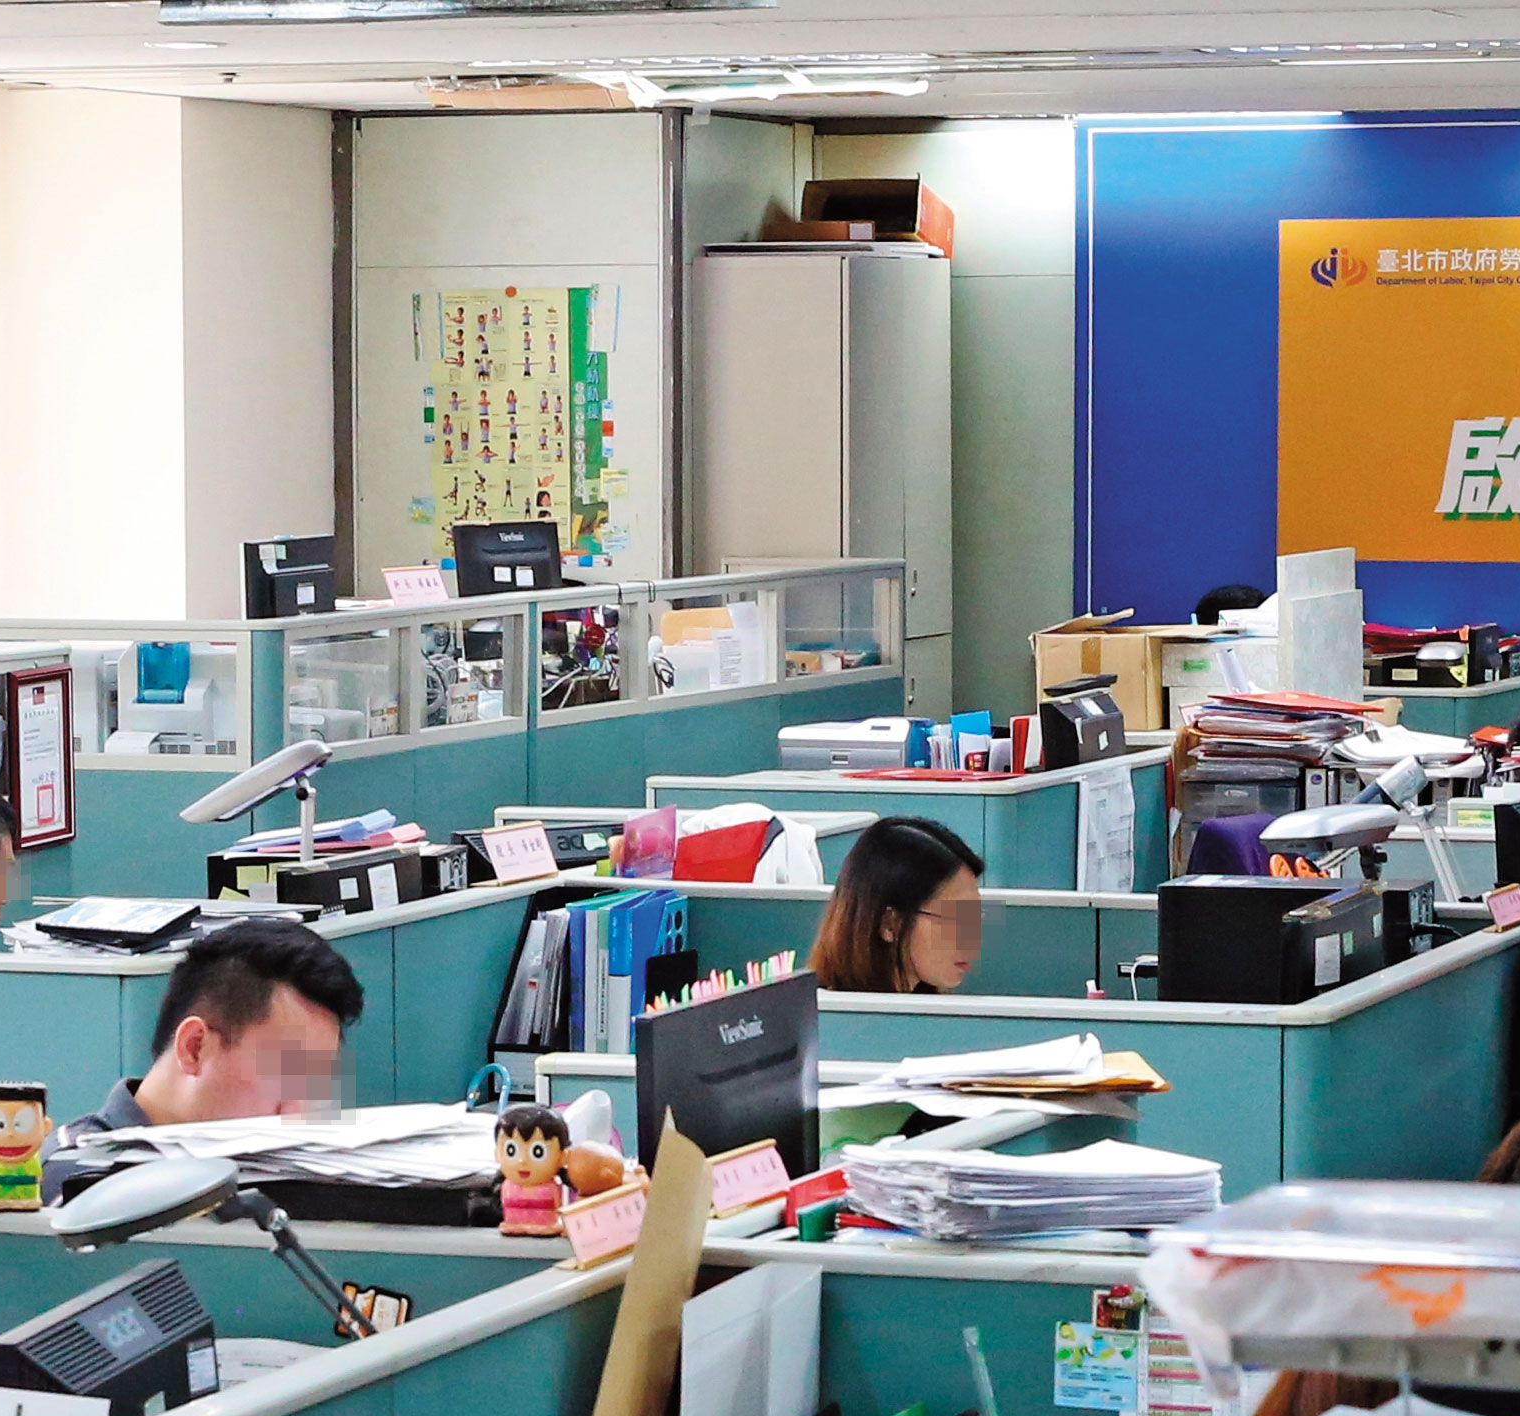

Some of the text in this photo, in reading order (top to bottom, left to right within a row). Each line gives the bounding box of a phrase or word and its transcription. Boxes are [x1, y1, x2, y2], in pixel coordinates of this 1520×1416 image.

[1376, 276, 1426, 286] Department
[1428, 276, 1438, 285] of
[1439, 276, 1466, 286] Labor,
[1468, 275, 1495, 287] Taipei
[1496, 275, 1513, 286] City
[557, 834, 583, 851] ac
[719, 1014, 765, 1046] ViewSonic
